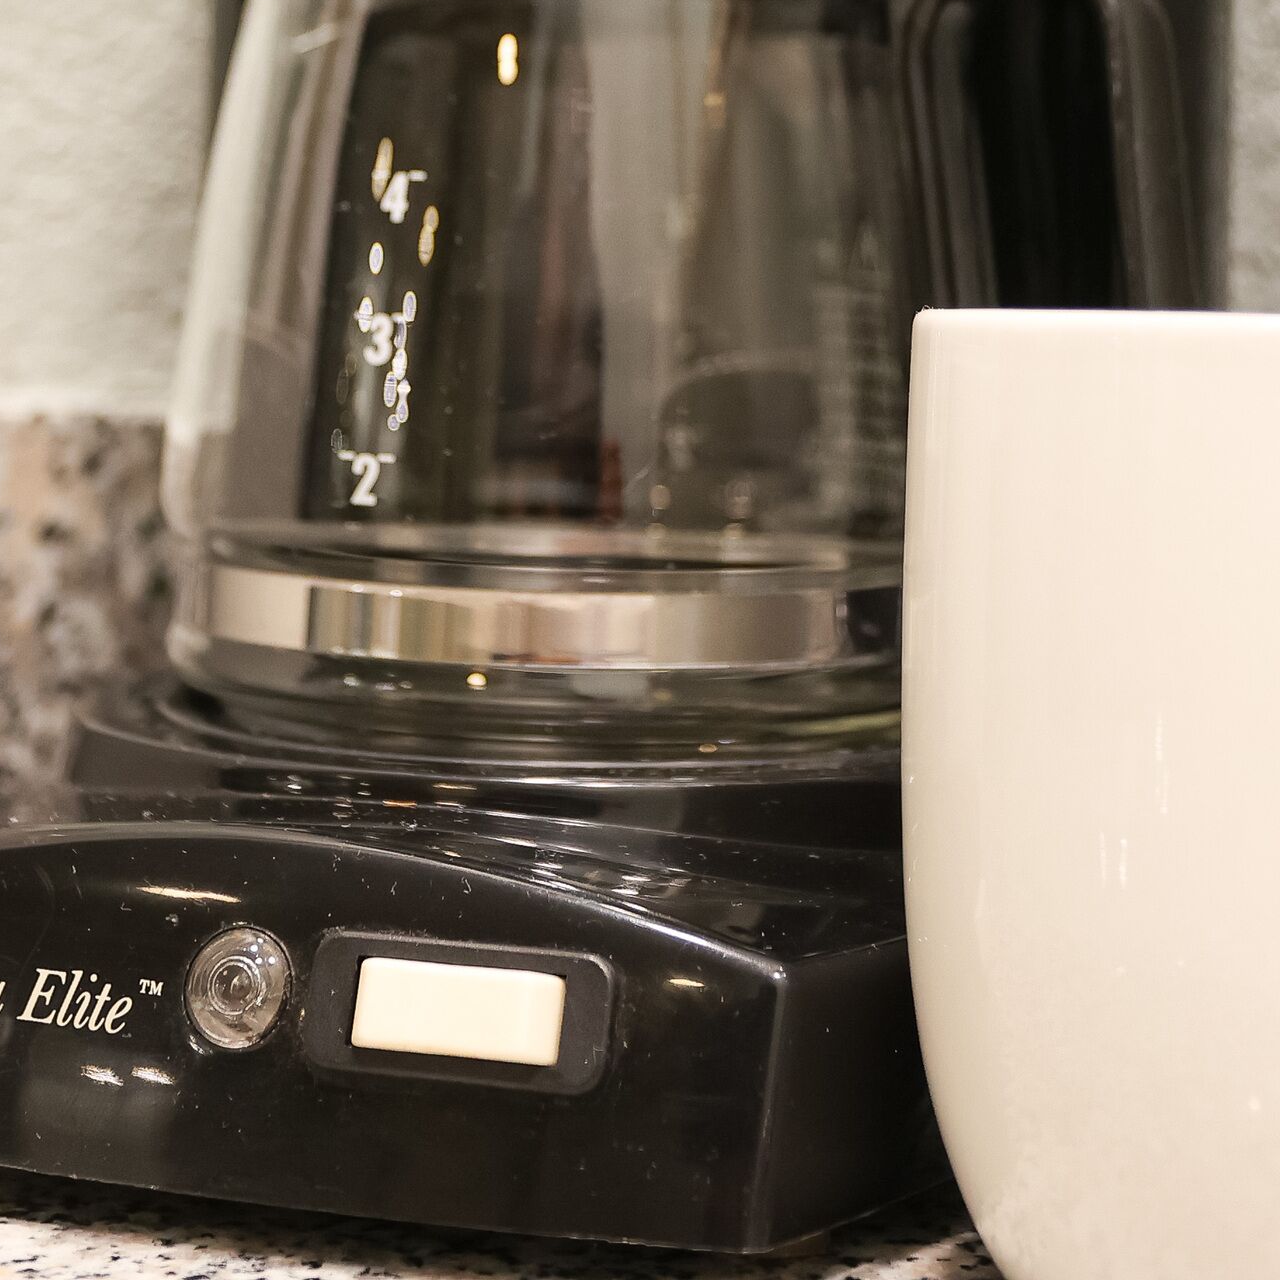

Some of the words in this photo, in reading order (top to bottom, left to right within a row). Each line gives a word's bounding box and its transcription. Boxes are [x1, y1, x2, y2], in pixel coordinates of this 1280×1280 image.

[380, 170, 411, 223] 4
[362, 312, 394, 366] 3
[349, 453, 381, 506] 2
